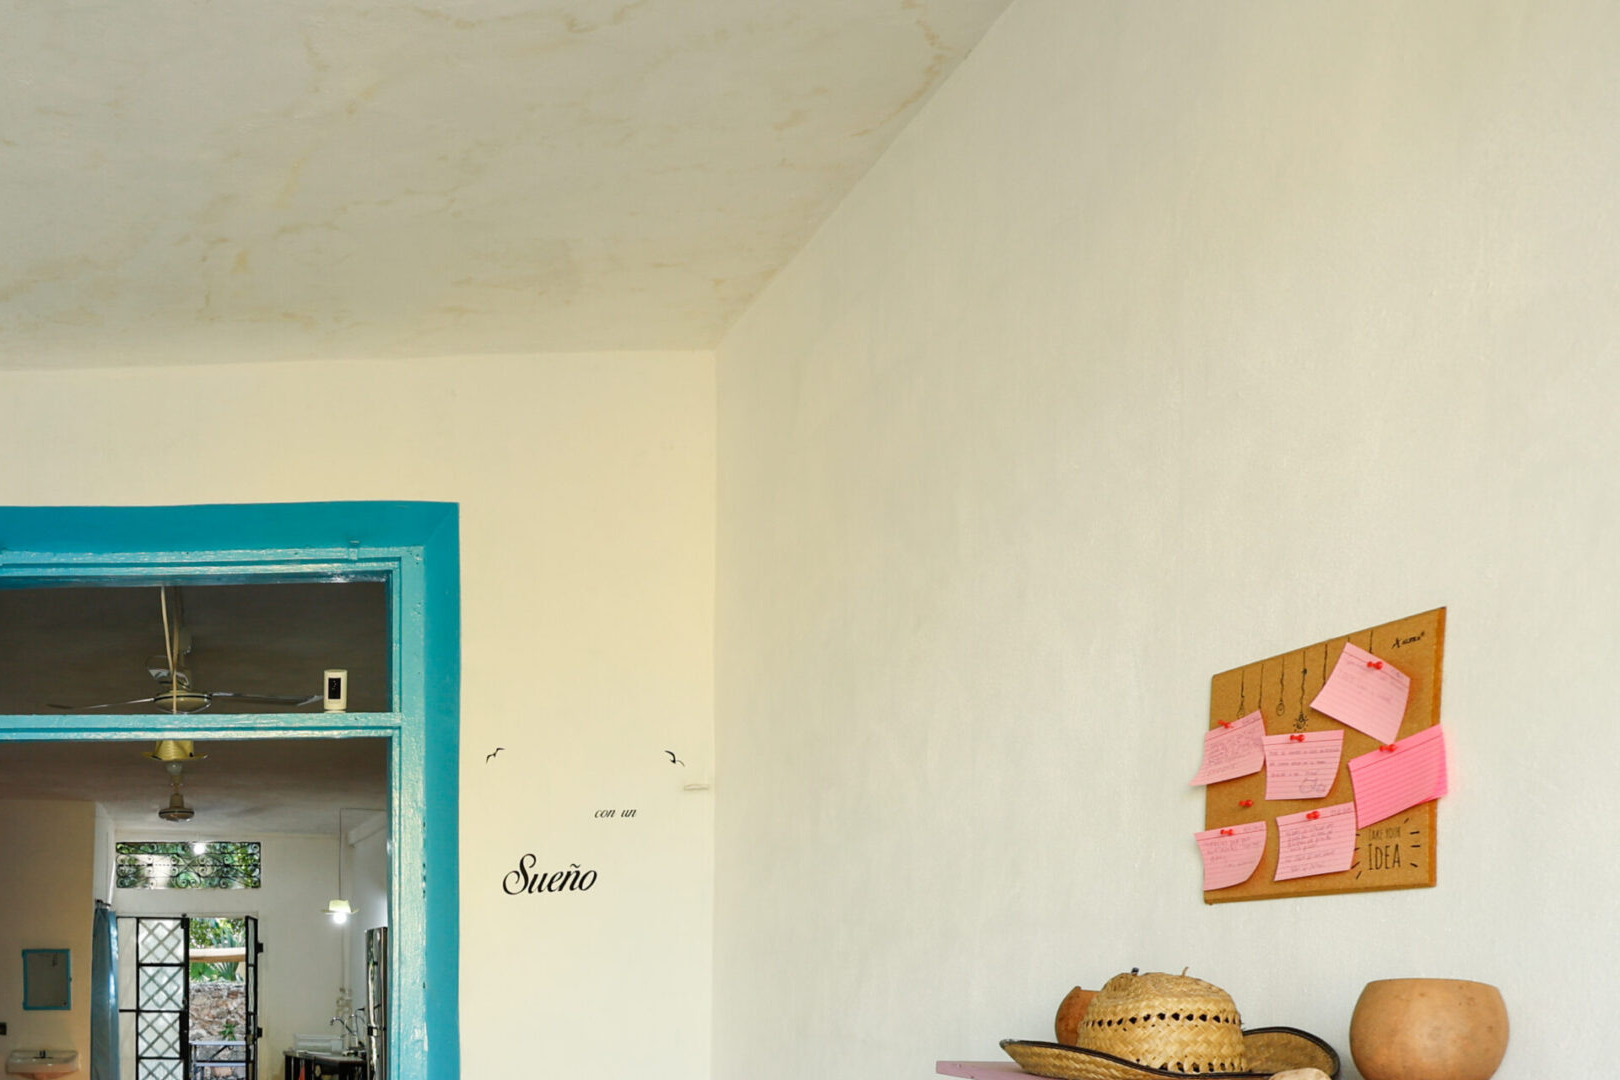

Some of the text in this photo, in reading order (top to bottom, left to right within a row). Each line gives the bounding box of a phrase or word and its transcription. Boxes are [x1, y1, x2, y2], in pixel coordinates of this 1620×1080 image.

[594, 809, 637, 818] con un
[502, 853, 598, 895] Sueño
